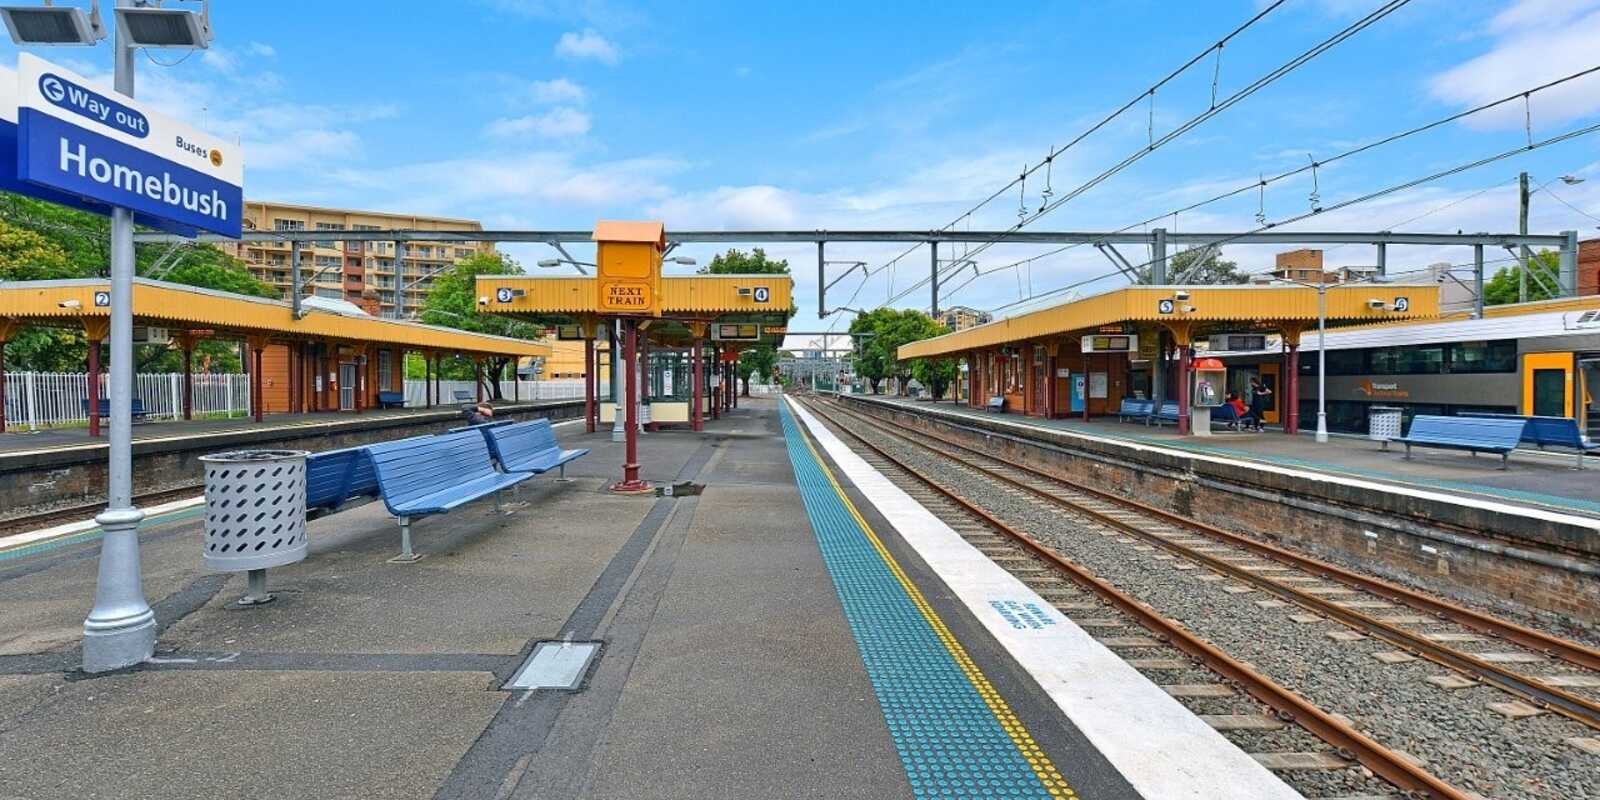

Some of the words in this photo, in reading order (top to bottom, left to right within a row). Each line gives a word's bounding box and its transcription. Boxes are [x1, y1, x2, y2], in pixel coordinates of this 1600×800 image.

[67, 86, 111, 120] Way
[115, 111, 145, 132] out
[175, 135, 208, 158] Buses
[60, 137, 227, 221] Homebush
[608, 296, 645, 304] TRAIN
[610, 287, 642, 295] NEXT
